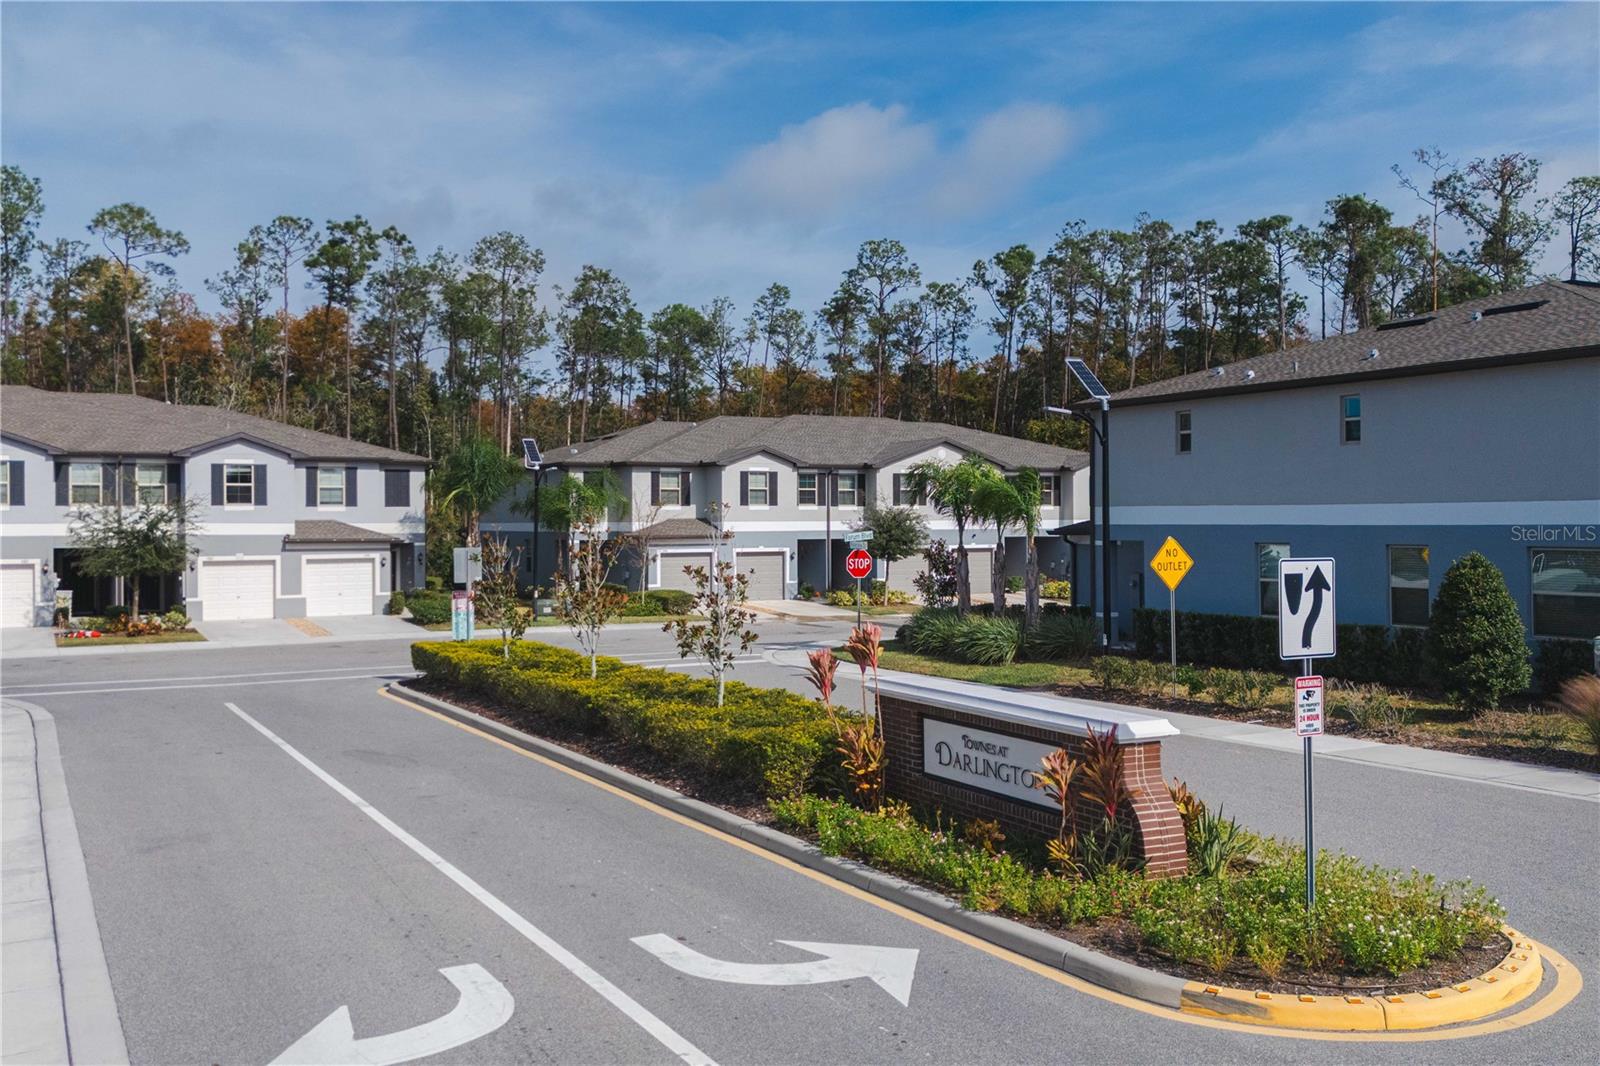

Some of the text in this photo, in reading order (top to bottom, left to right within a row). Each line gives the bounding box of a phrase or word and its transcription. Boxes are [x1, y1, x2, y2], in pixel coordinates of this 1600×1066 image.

[1165, 548, 1178, 557] NO
[848, 558, 870, 569] STOP
[1157, 561, 1187, 571] OUTLET
[1297, 679, 1321, 688] WARNING
[997, 746, 1009, 758] AT
